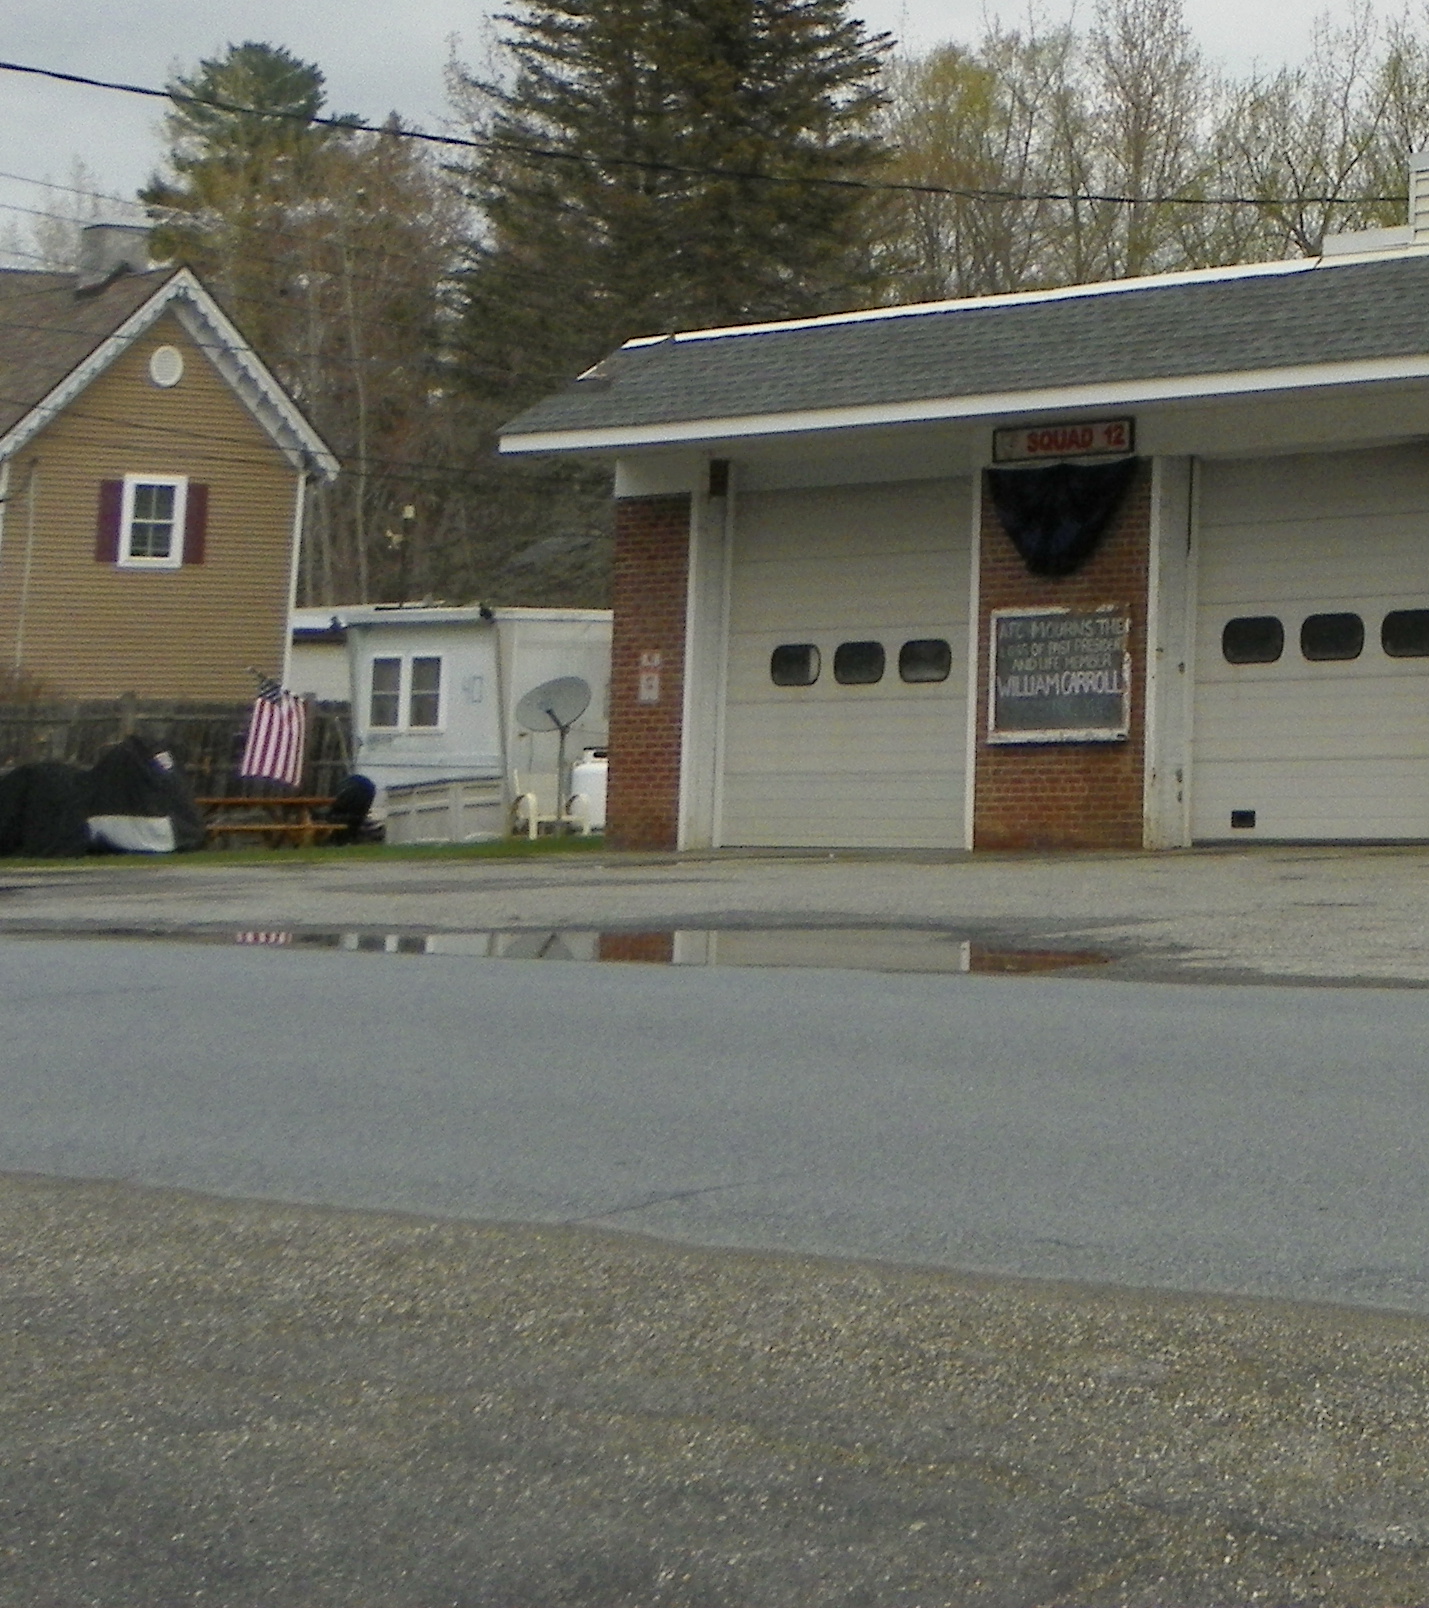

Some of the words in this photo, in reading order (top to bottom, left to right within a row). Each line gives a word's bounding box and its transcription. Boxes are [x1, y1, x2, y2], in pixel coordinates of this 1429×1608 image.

[1027, 427, 1093, 452] SQUAD
[1104, 423, 1126, 446] 12
[1030, 619, 1093, 638] MOURNS
[1012, 657, 1037, 671] AND
[997, 672, 1060, 697] WILLIAM
[1061, 670, 1126, 695] CARROLL
